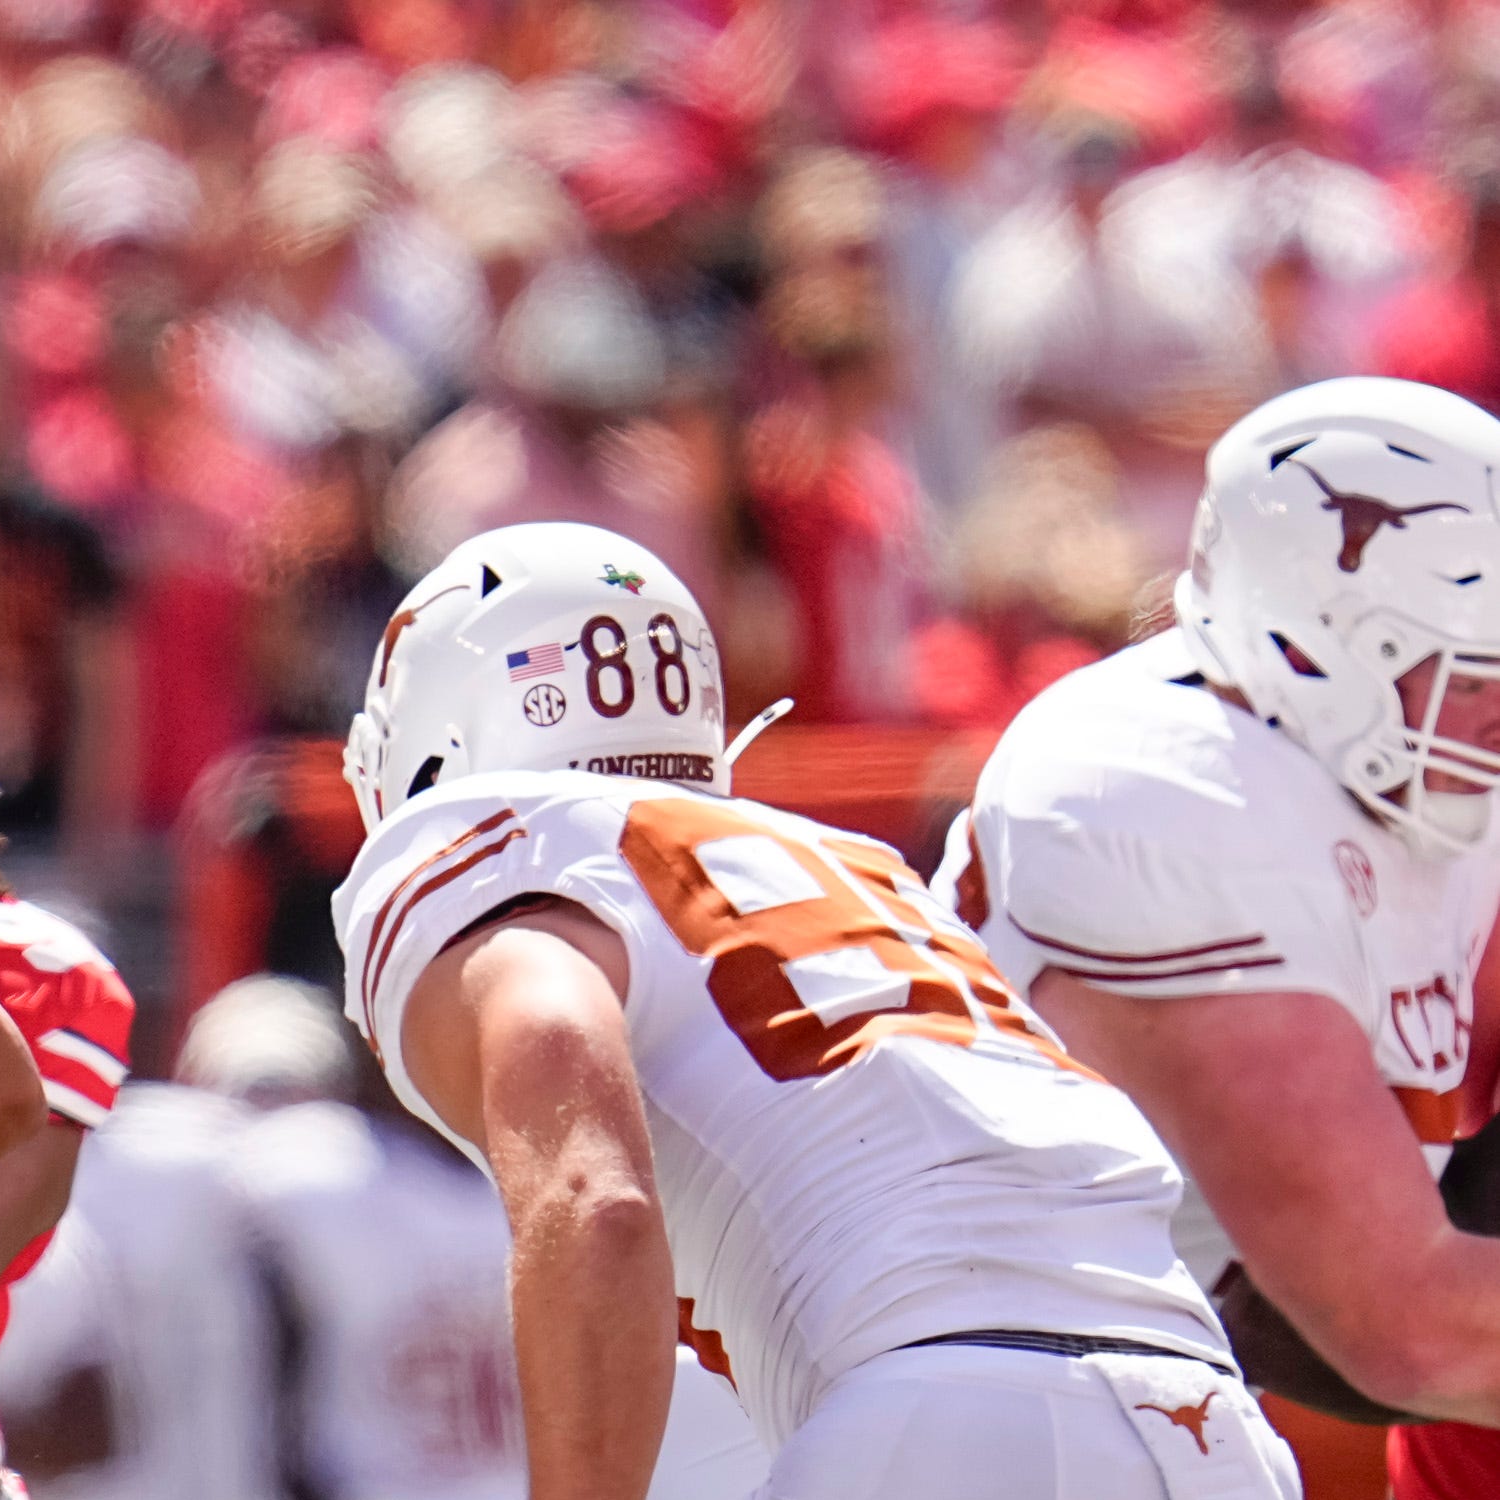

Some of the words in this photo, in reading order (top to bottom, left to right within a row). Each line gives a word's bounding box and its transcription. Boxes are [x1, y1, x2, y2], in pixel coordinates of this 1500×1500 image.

[523, 684, 567, 728] SEC
[580, 612, 690, 719] 88
[618, 797, 1108, 1083] 88
